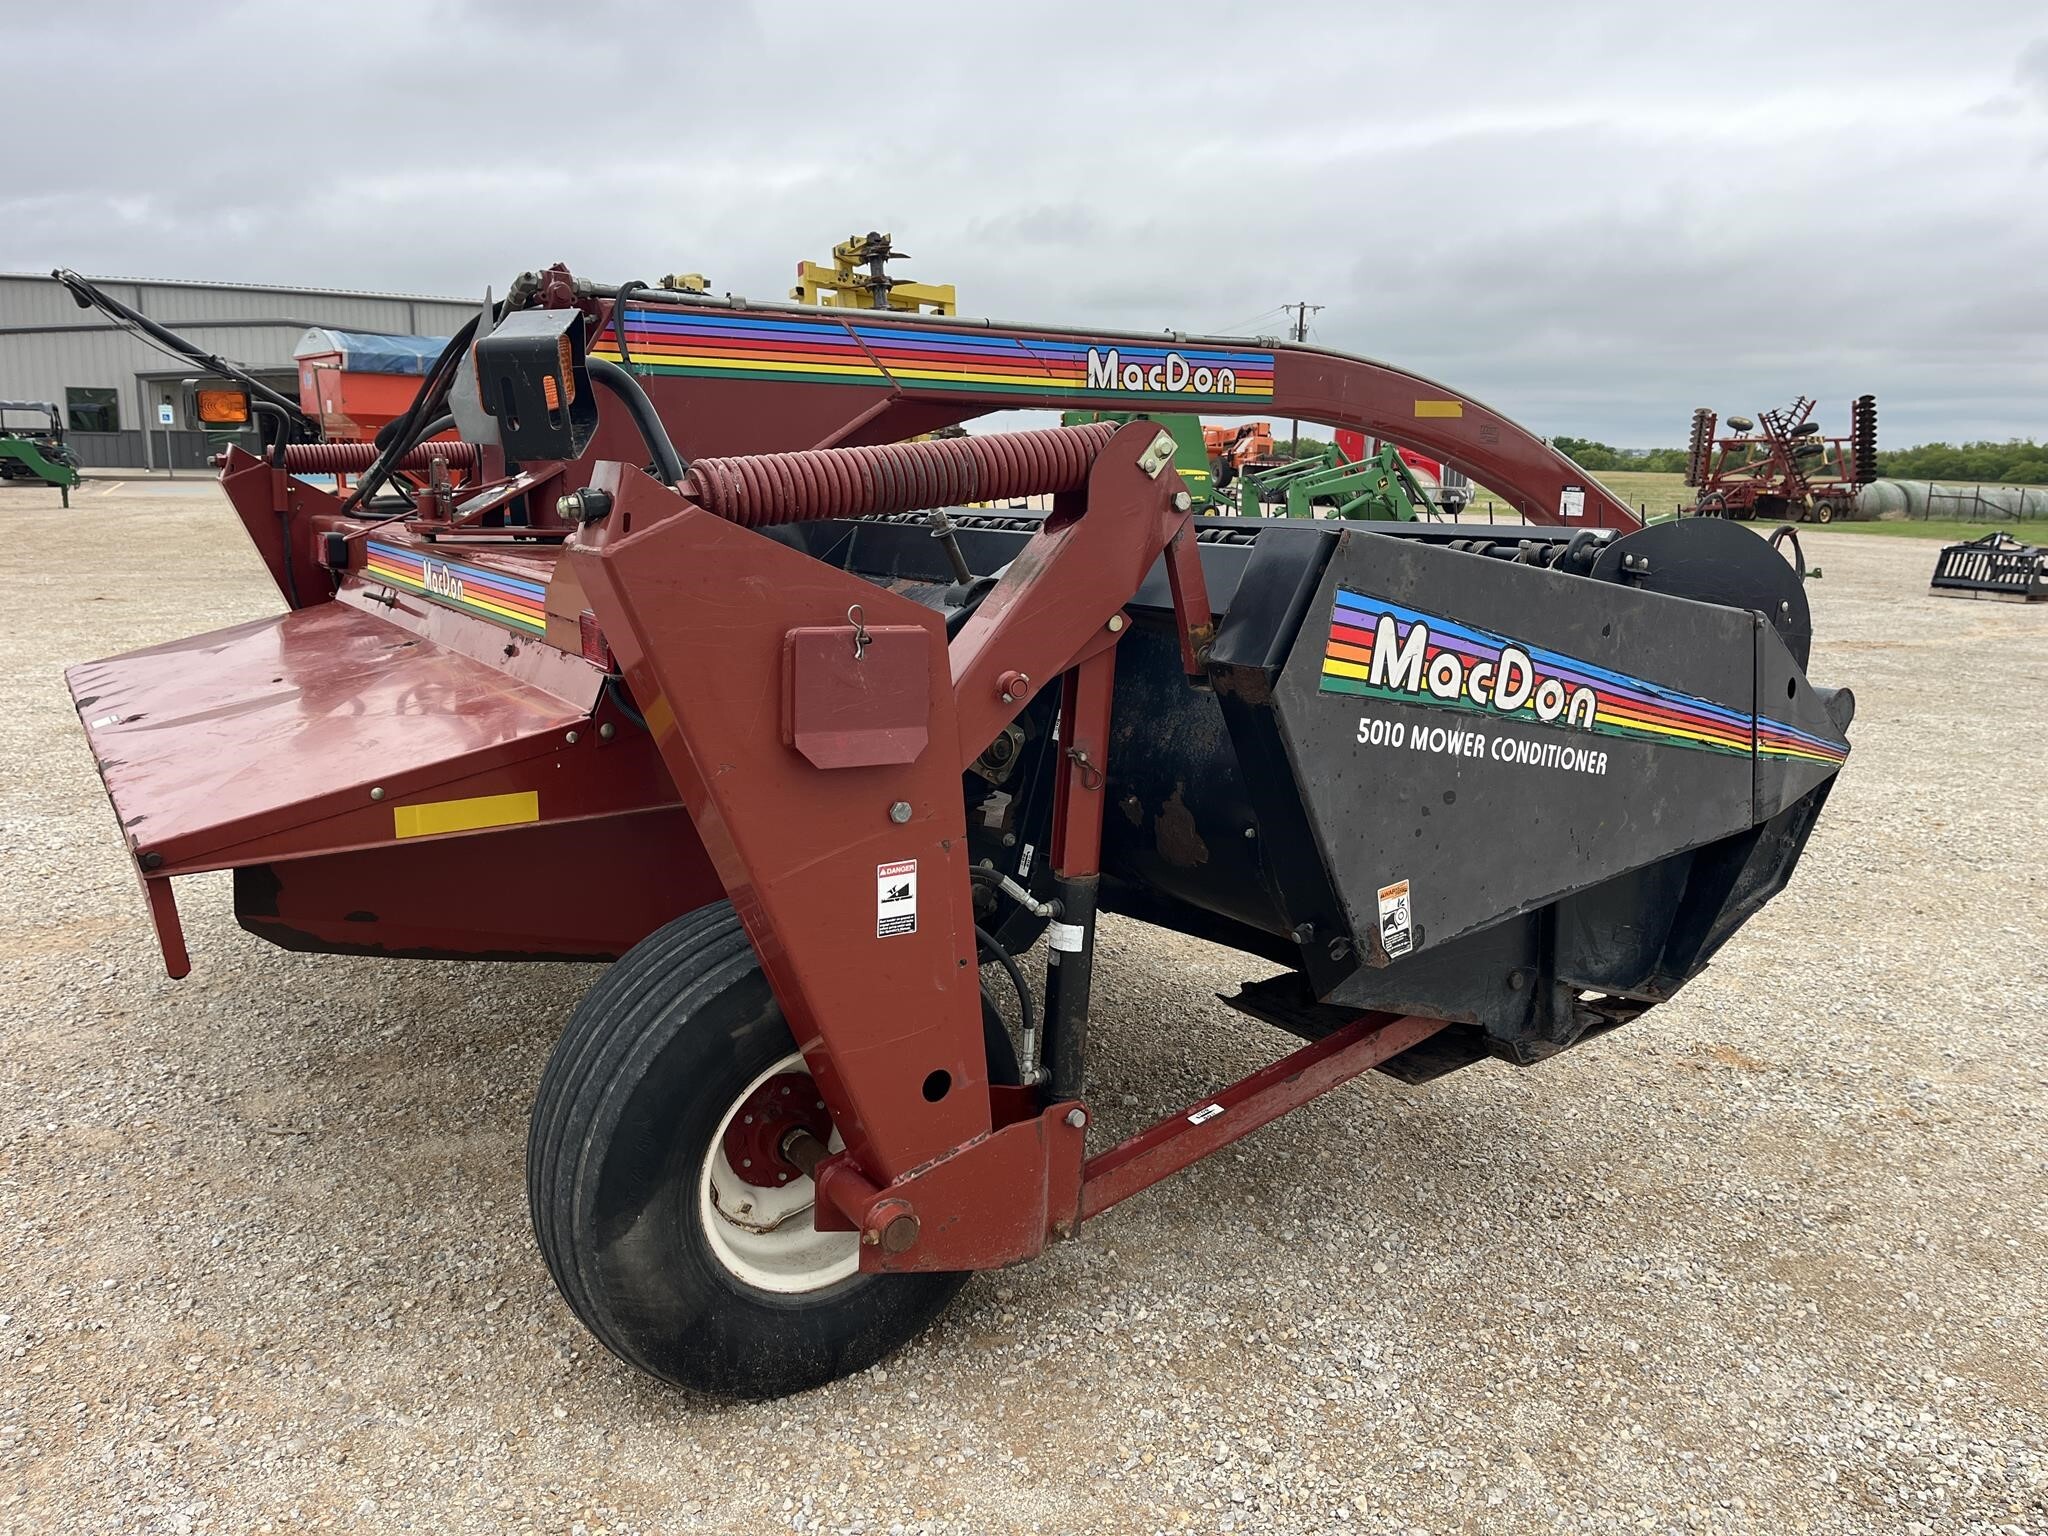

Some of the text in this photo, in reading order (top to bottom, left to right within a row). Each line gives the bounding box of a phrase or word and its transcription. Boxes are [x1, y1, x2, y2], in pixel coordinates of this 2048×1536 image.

[1087, 348, 1235, 394] MacDon
[423, 559, 465, 602] MacDon
[1368, 614, 1598, 729] MacDon
[1356, 717, 1608, 776] 5010 MOWER CONDITIONER
[886, 864, 914, 875] DANGER
